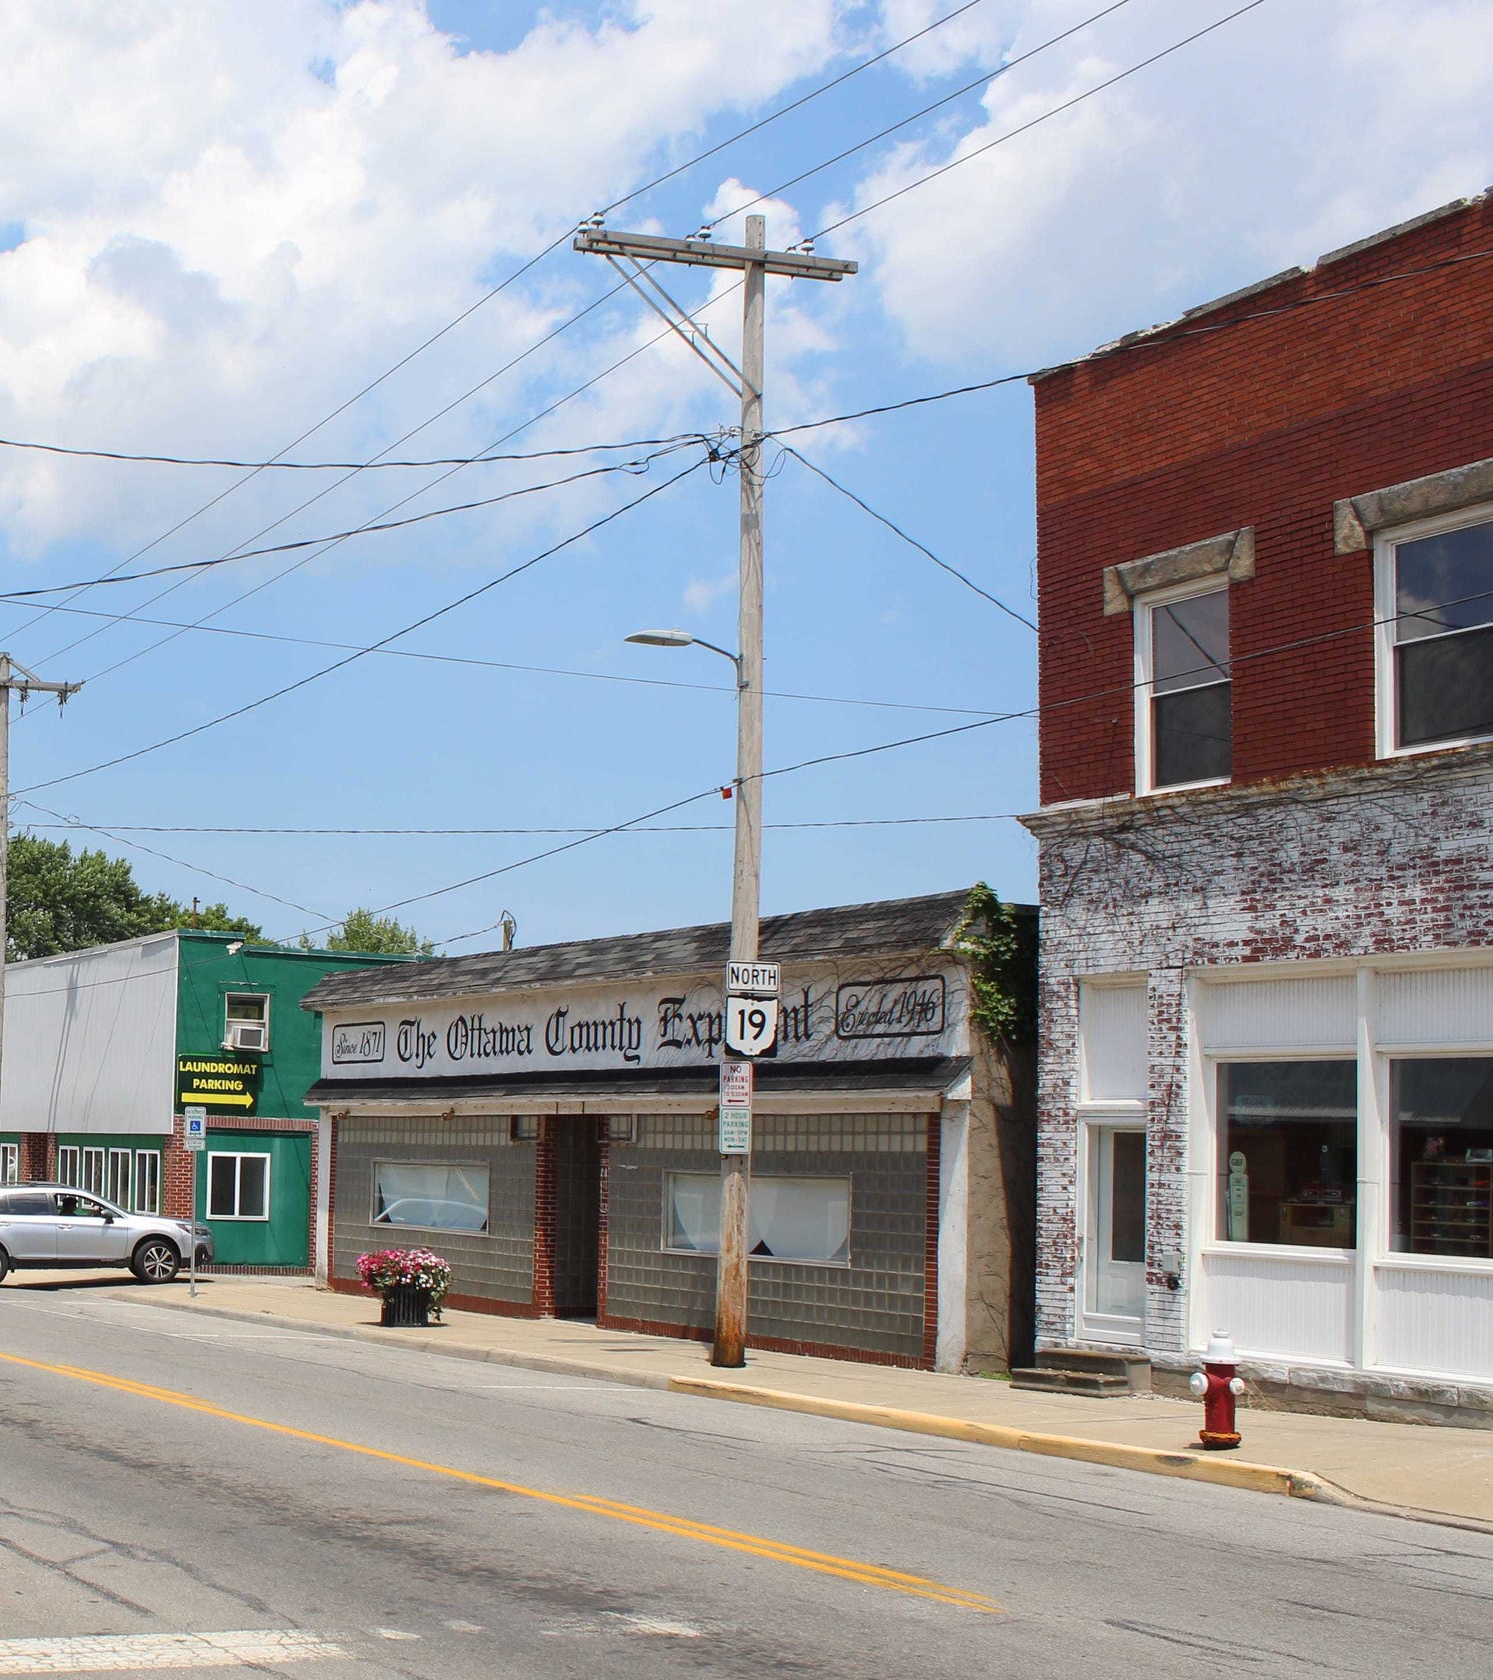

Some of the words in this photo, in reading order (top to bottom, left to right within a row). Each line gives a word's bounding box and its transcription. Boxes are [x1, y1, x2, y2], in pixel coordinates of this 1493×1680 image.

[730, 966, 777, 986] NORTH
[840, 993, 895, 1033] Erected
[895, 988, 940, 1027] 1946
[397, 1015, 437, 1069] The
[446, 1012, 535, 1061] Ottawa
[545, 1001, 643, 1065] County
[657, 984, 814, 1059] Expnt
[737, 1008, 767, 1041] 19
[335, 1032, 358, 1058] Since
[359, 1030, 382, 1057] 1871
[179, 1061, 257, 1075] LAUNDROMAT
[729, 1065, 742, 1074] NO
[192, 1078, 244, 1091] PARKING
[723, 1075, 749, 1083] PARKING
[724, 1112, 729, 1120] 2
[723, 1120, 749, 1128] PARKING
